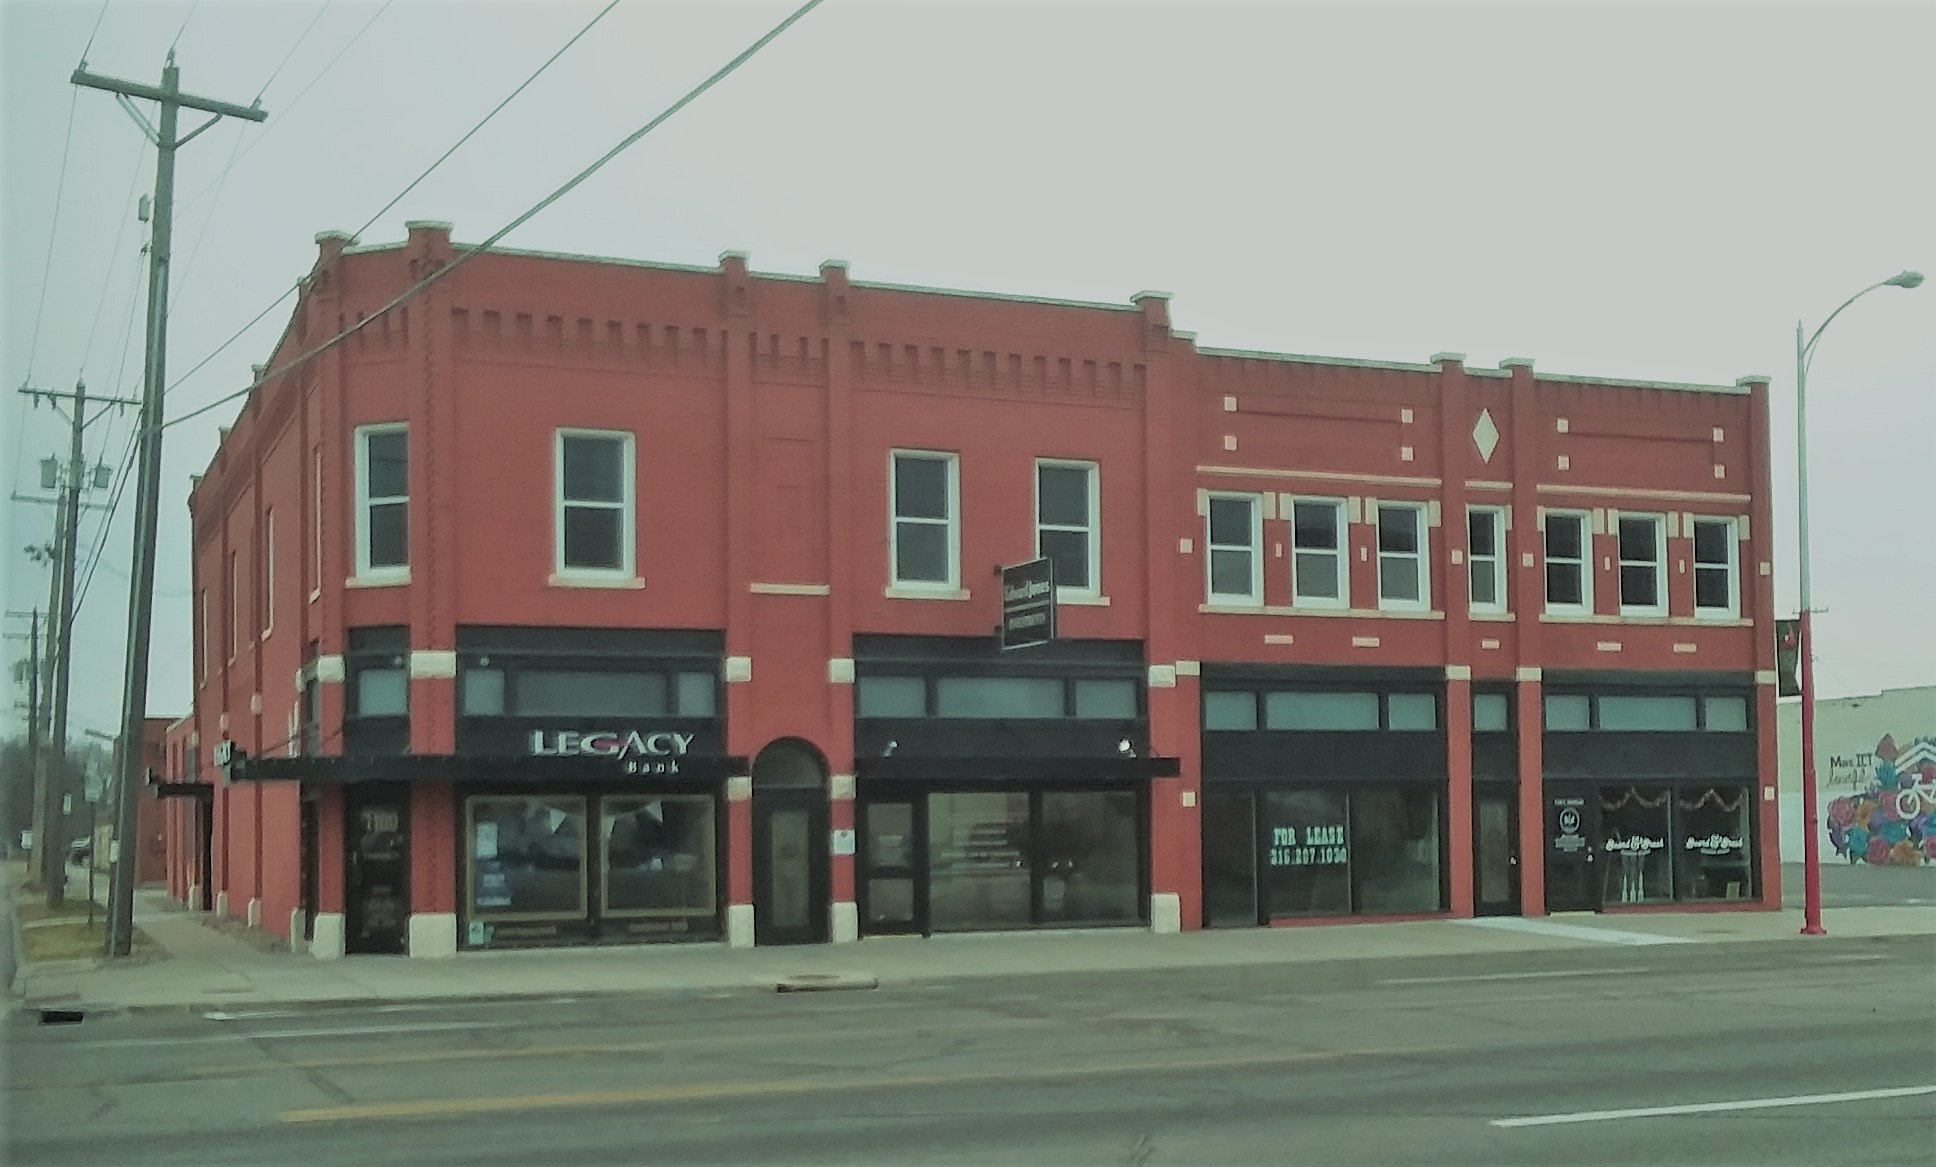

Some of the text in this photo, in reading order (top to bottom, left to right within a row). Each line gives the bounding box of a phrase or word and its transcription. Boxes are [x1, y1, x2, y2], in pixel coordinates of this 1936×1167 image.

[533, 730, 694, 760] LEGACY
[628, 760, 680, 774] Bank
[1273, 826, 1344, 846] FOR LEASE
